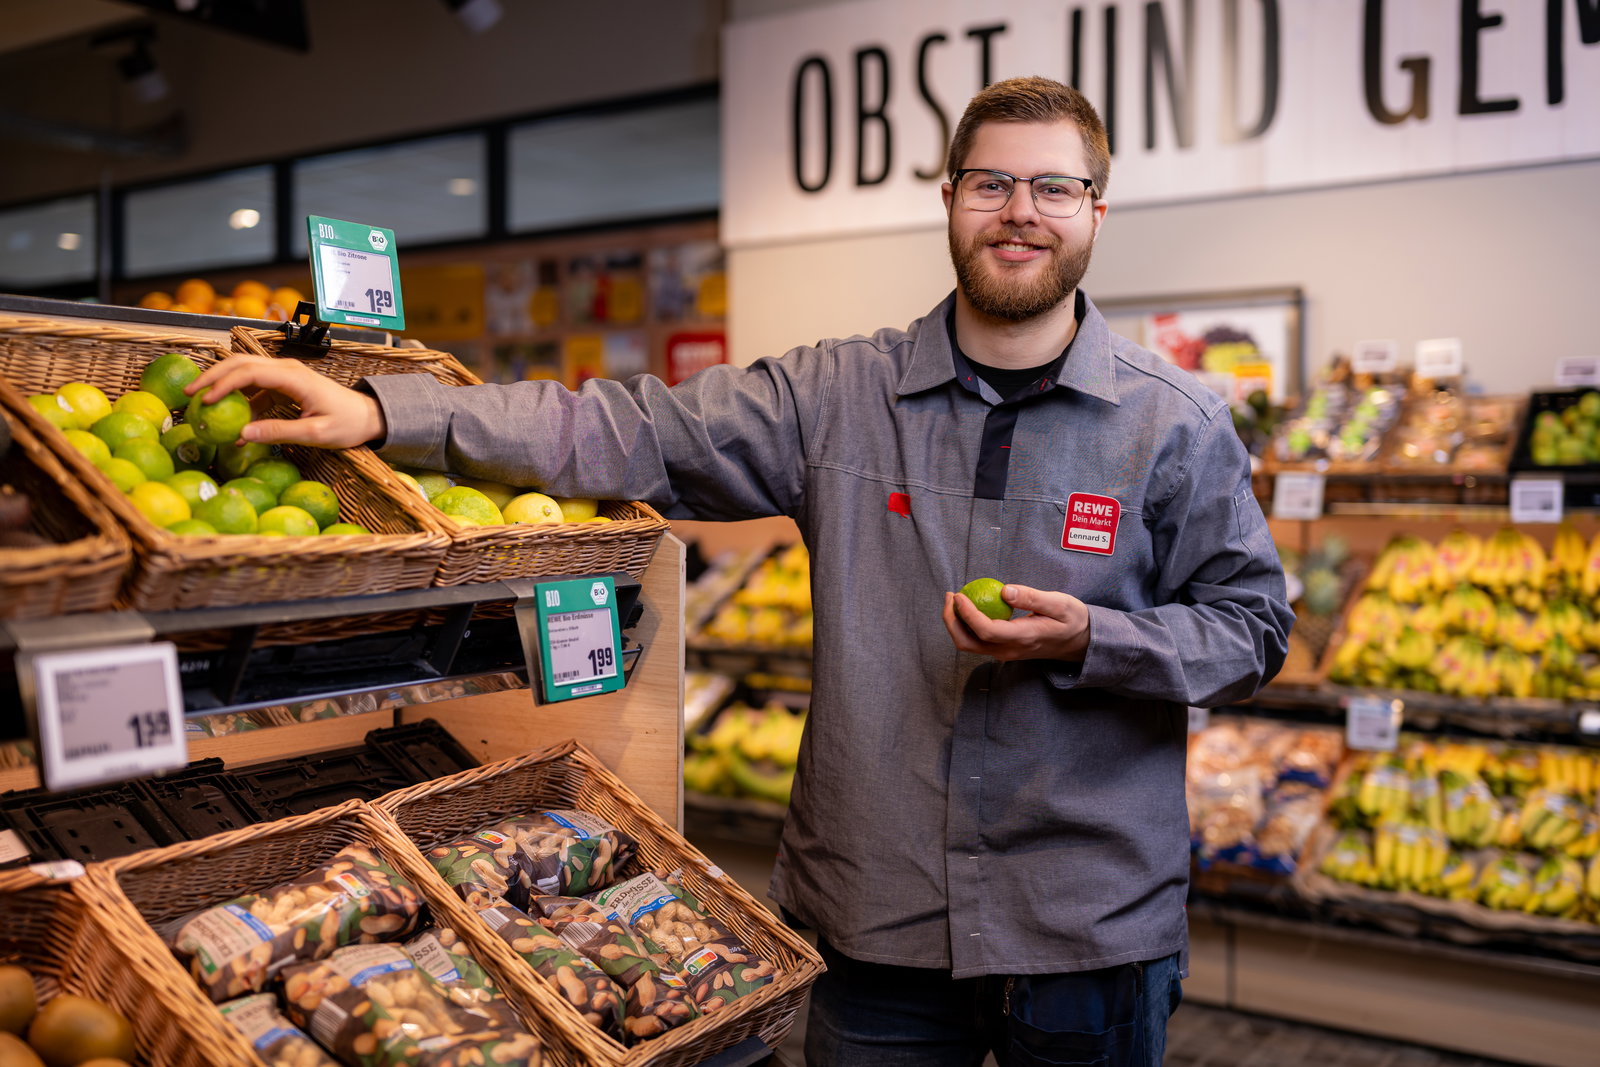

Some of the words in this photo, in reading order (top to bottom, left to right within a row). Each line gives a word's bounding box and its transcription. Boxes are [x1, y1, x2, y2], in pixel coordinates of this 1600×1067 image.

[1071, 0, 1282, 156] UND
[318, 223, 334, 240] BIO
[348, 251, 368, 261] Zitrone
[1073, 501, 1114, 517] REWE
[1072, 514, 1088, 524] Dein
[1090, 516, 1112, 527] Markt
[1069, 532, 1100, 542] Lennard
[1101, 535, 1109, 543] S.
[545, 589, 561, 608] BIO
